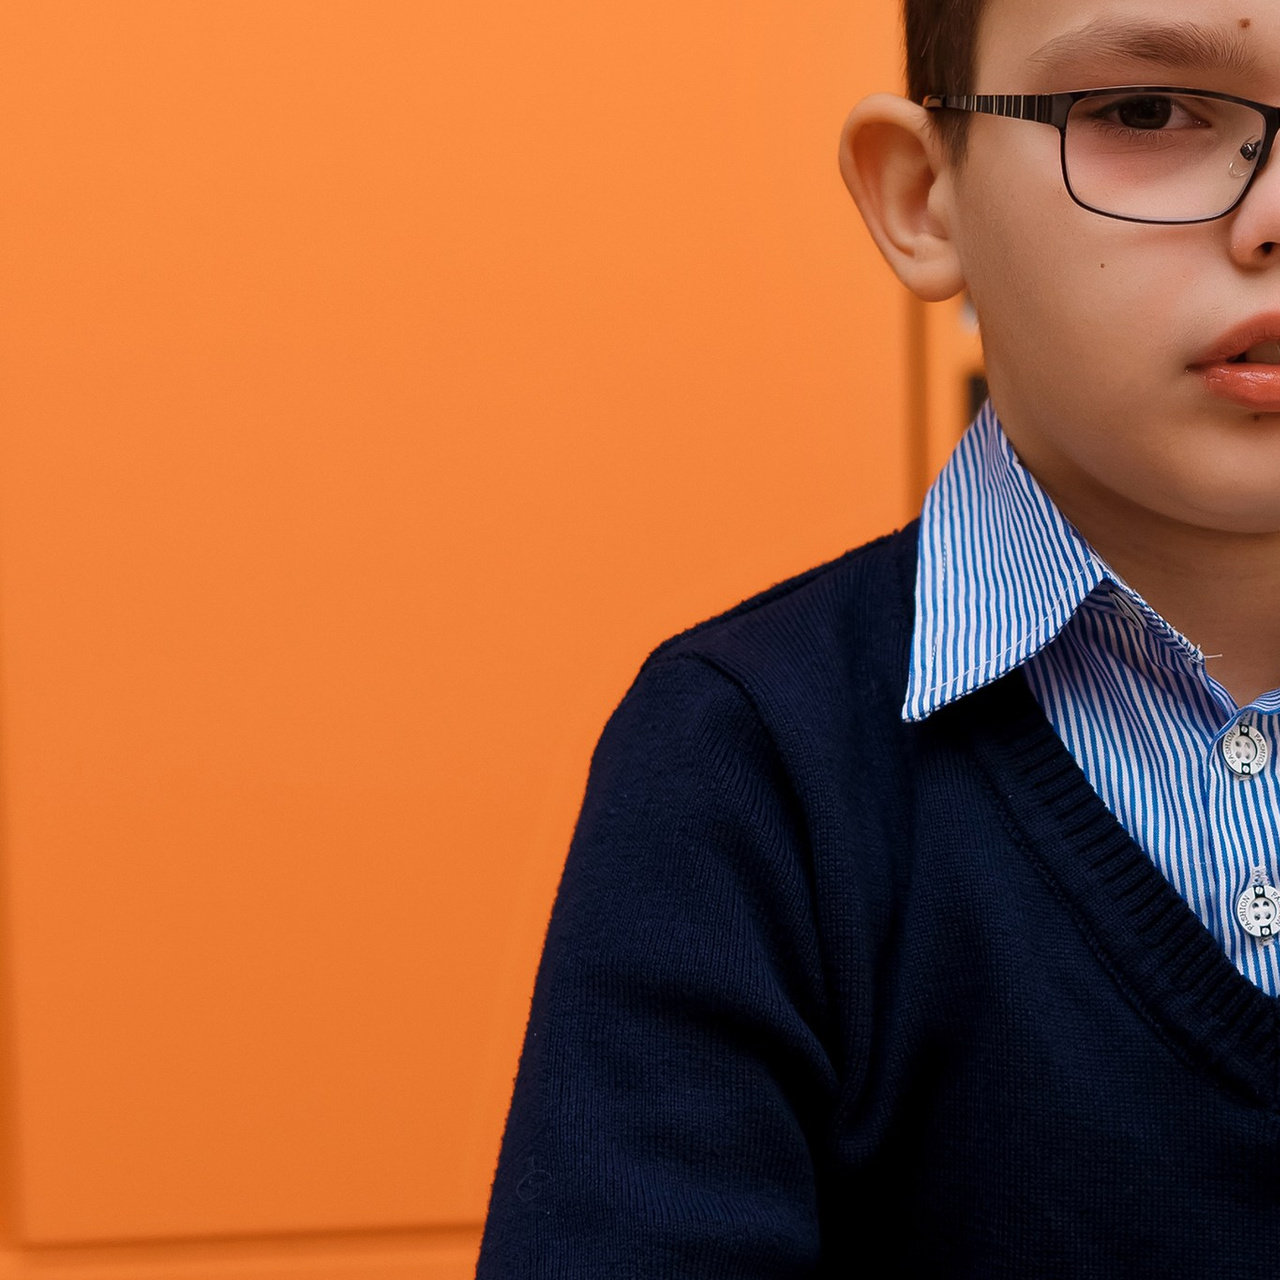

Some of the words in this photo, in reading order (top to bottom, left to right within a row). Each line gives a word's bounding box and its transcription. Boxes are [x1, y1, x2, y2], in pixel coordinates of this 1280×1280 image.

[1225, 729, 1237, 765] FASHION
[1254, 733, 1266, 768] FASHION
[1239, 894, 1255, 931] FASHION
